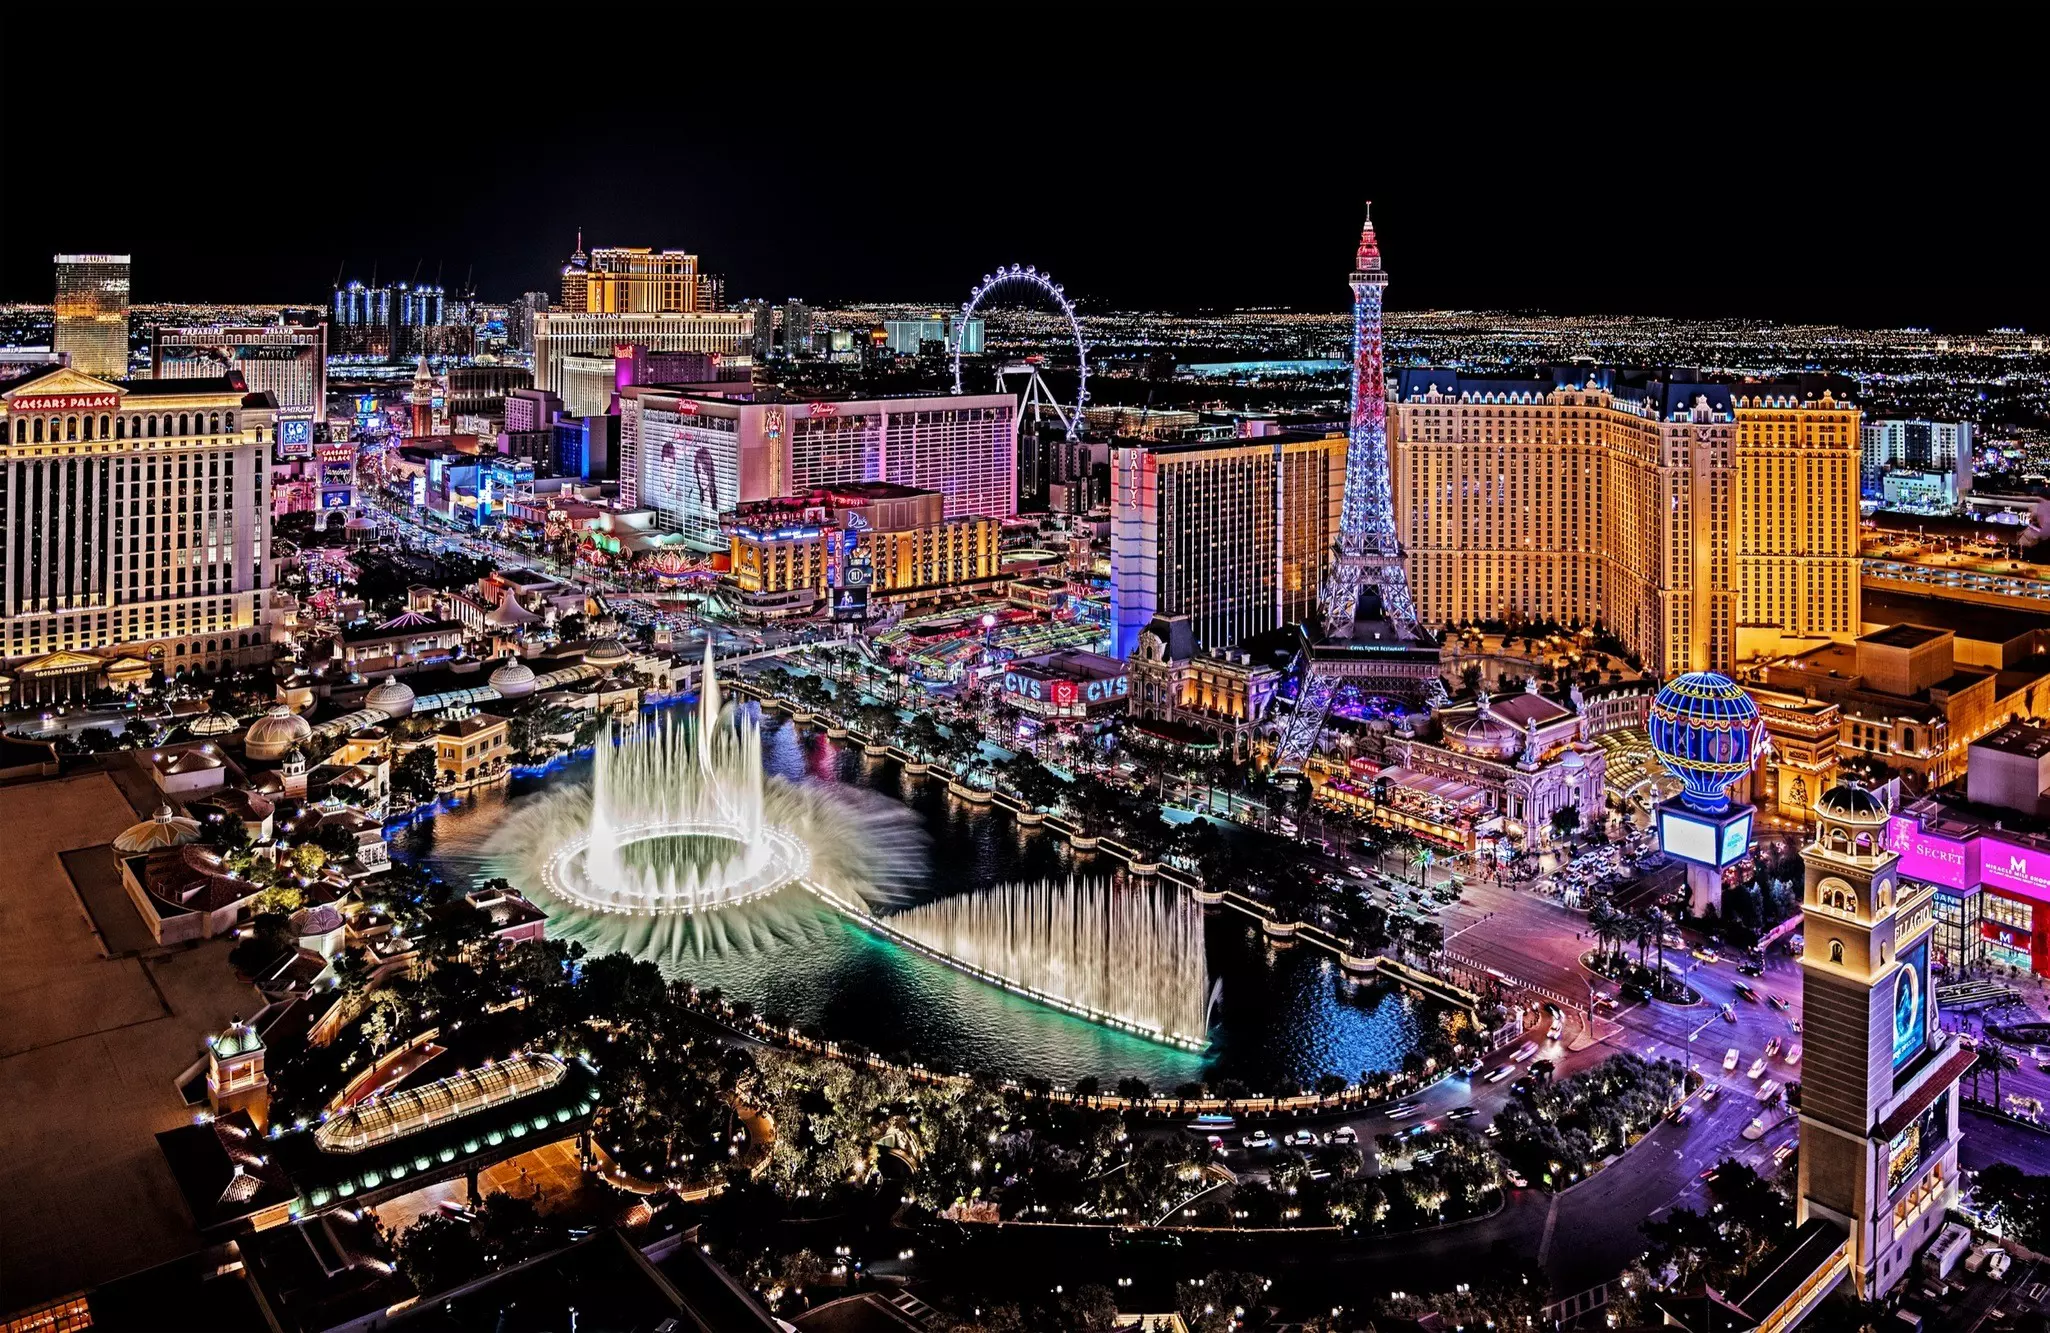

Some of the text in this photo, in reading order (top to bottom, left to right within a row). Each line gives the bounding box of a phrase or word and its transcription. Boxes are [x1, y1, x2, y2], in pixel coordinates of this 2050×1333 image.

[80, 254, 112, 263] TRUMP
[564, 266, 588, 276] Encore
[13, 396, 116, 410] CAESARS PALACE
[286, 405, 314, 413] MIRAGE
[851, 571, 860, 581] BLT
[64, 666, 88, 674] PALACE
[1005, 672, 1041, 699] CVS
[1087, 676, 1127, 701] CVS
[1350, 760, 1379, 773] BEER PARK
[1916, 844, 1964, 865] SECRET
[1985, 863, 2012, 874] MIRACLE
[2014, 871, 2028, 879] MILE
[2011, 855, 2026, 874] M
[1895, 905, 1929, 942] ELLAGIO
[2000, 931, 2011, 944] M
